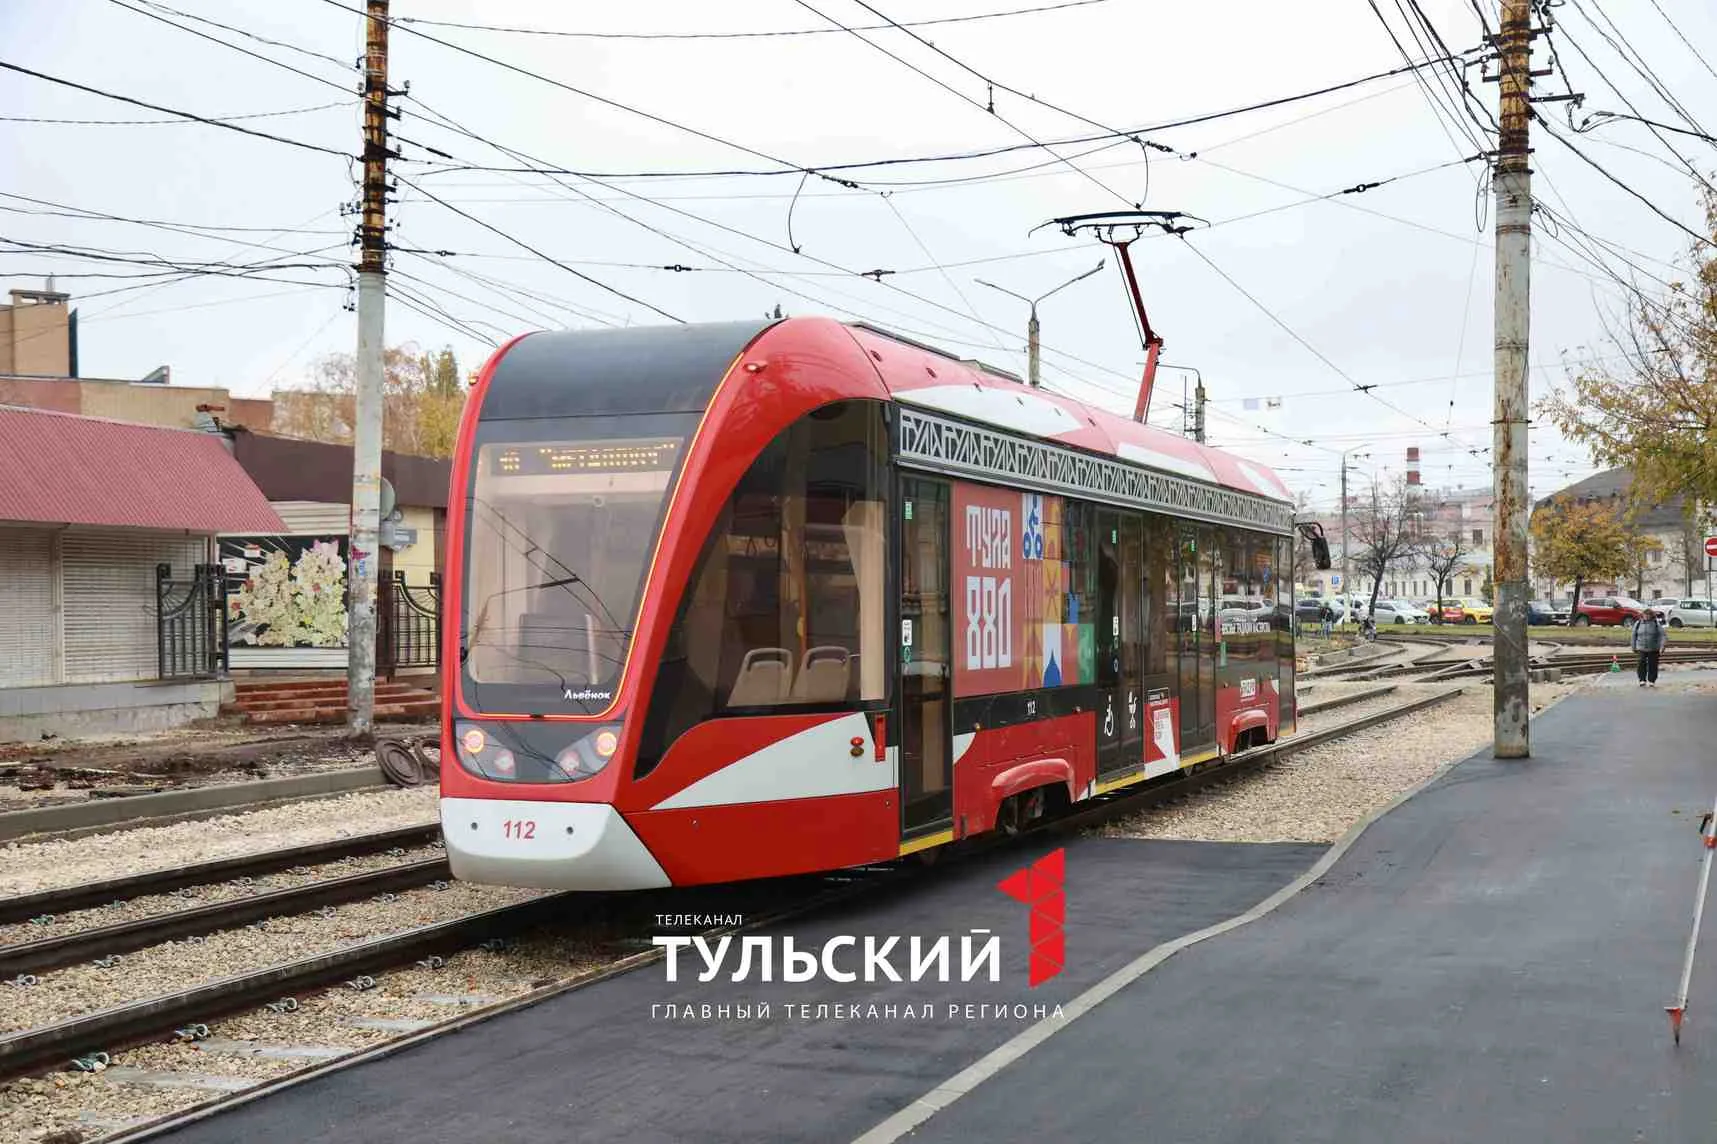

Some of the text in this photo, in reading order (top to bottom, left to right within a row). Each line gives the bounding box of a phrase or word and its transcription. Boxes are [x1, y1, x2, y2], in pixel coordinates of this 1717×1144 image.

[966, 576, 1012, 670] 880
[564, 689, 610, 700] Львёнок
[503, 820, 536, 839] 112
